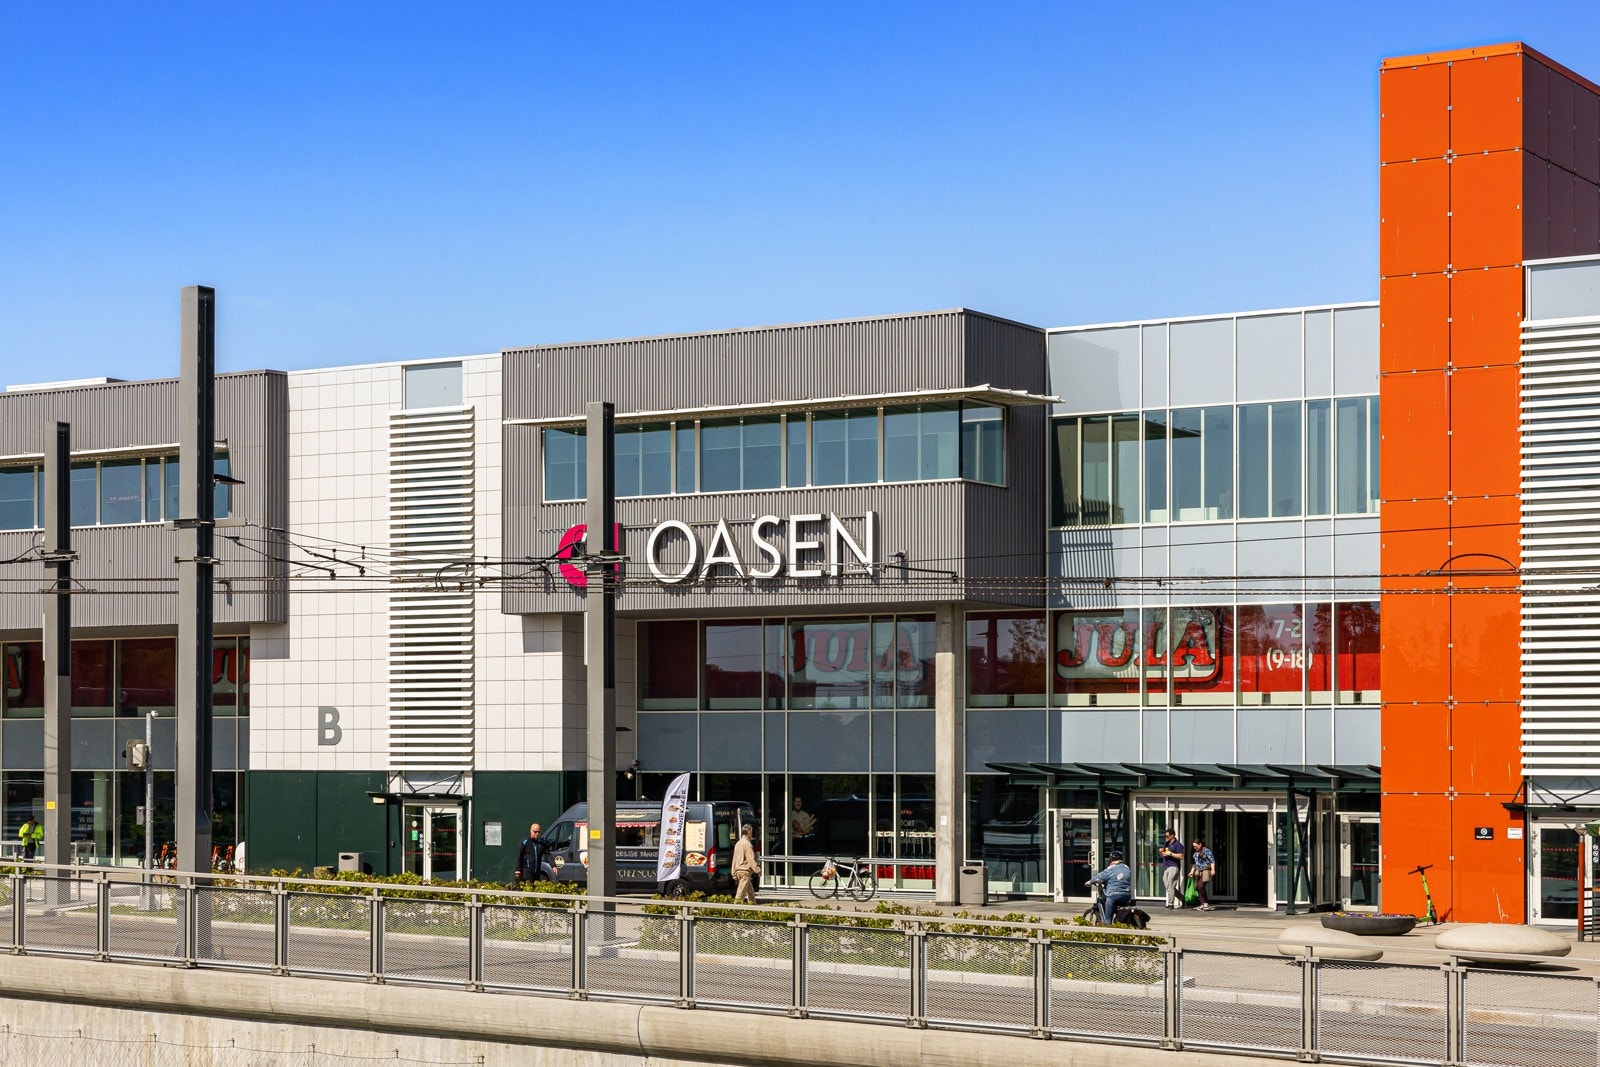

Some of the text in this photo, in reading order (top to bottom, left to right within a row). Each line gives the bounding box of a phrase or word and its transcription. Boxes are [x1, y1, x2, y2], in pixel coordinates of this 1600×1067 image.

[646, 511, 878, 584] OASEN
[780, 627, 919, 673] JULA
[1057, 620, 1216, 668] JULA
[1266, 646, 1313, 672] (9-18)
[317, 705, 343, 746] B
[677, 789, 687, 836] PANNEKAKER
